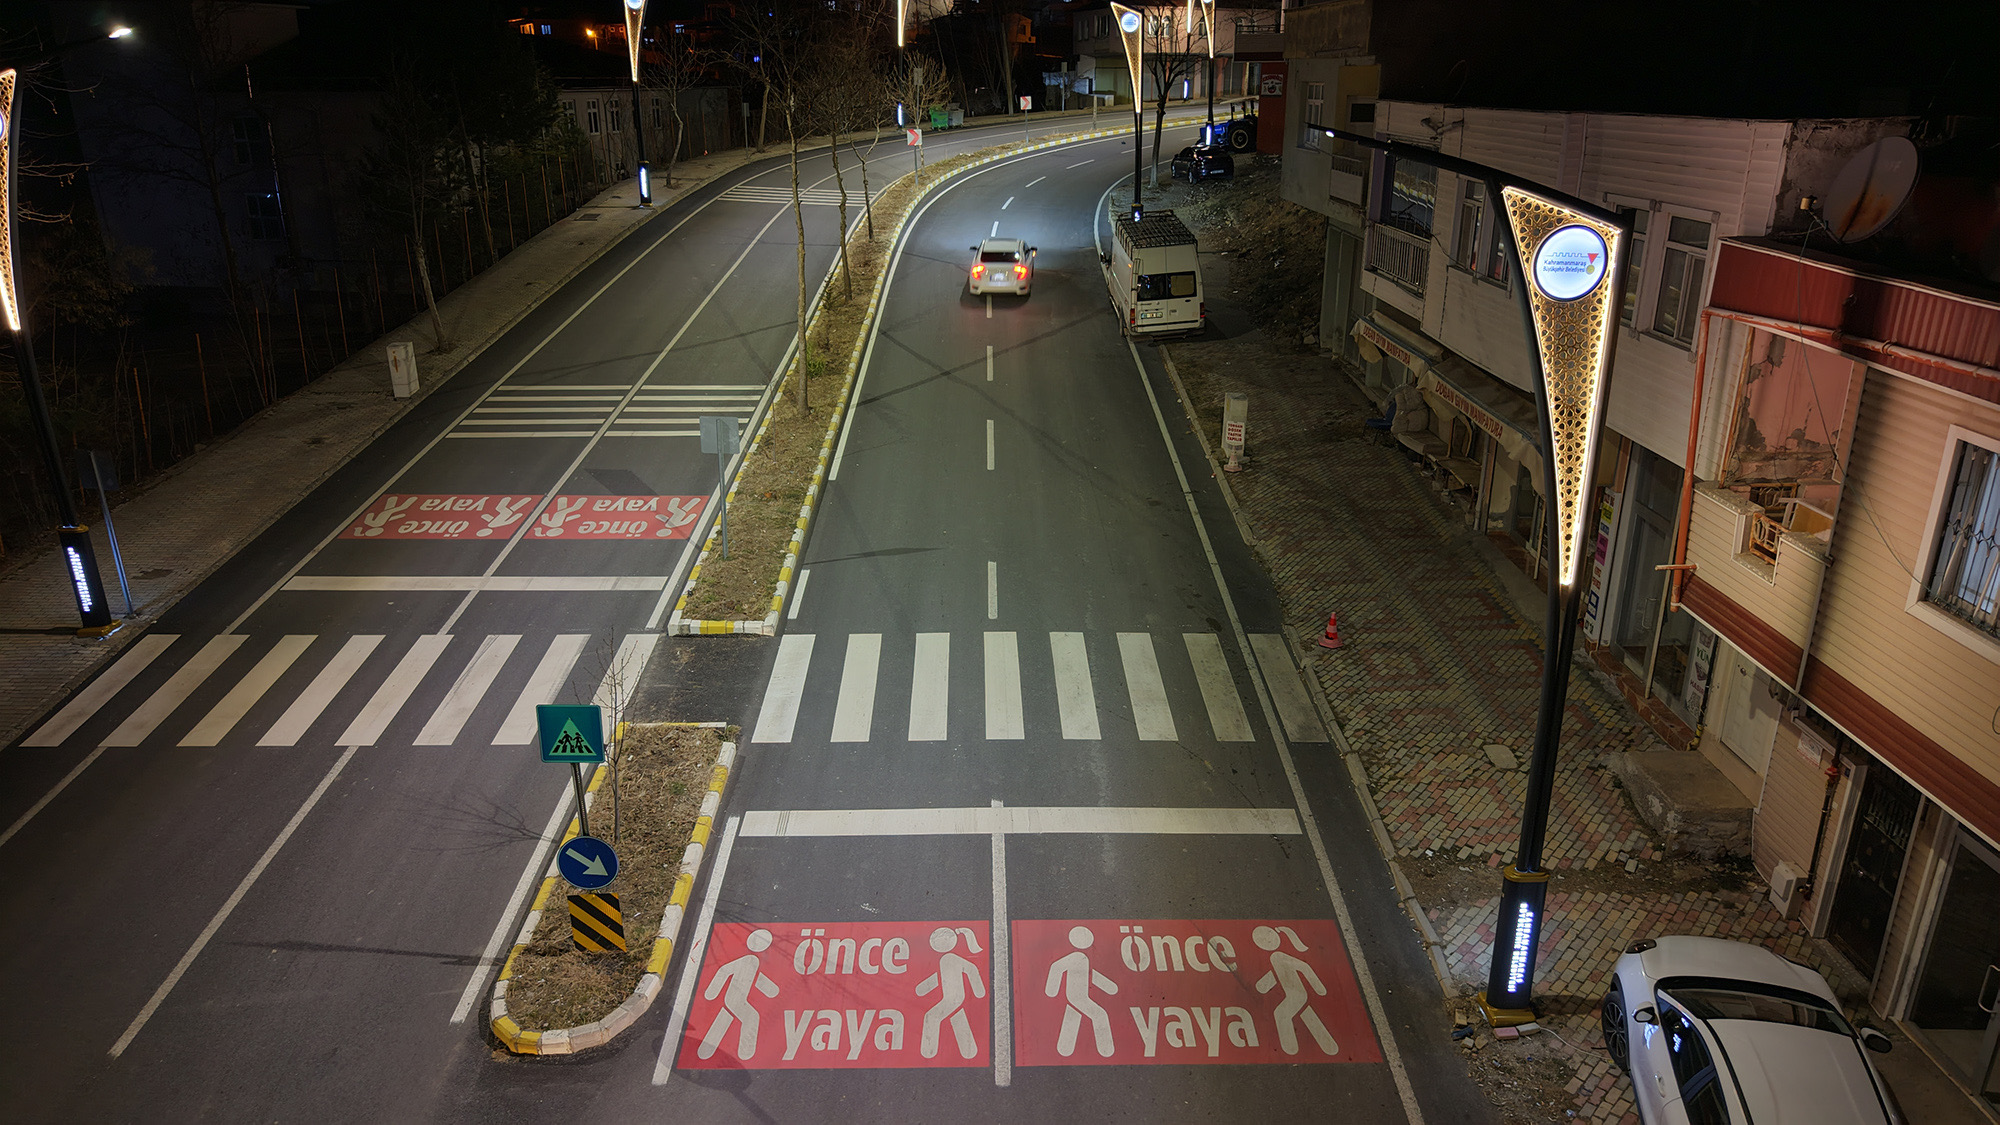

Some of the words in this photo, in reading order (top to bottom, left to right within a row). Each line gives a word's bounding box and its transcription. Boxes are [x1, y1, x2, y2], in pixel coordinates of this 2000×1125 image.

[1544, 259, 1587, 267] Kahramanmaraş
[419, 496, 485, 512] yaya
[592, 496, 656, 512] yaya
[397, 520, 470, 538] önce
[577, 520, 649, 538] önce
[793, 928, 911, 975] önce
[1120, 925, 1237, 973] önce
[781, 1008, 905, 1061] yaya
[1129, 1006, 1260, 1058] yaya
